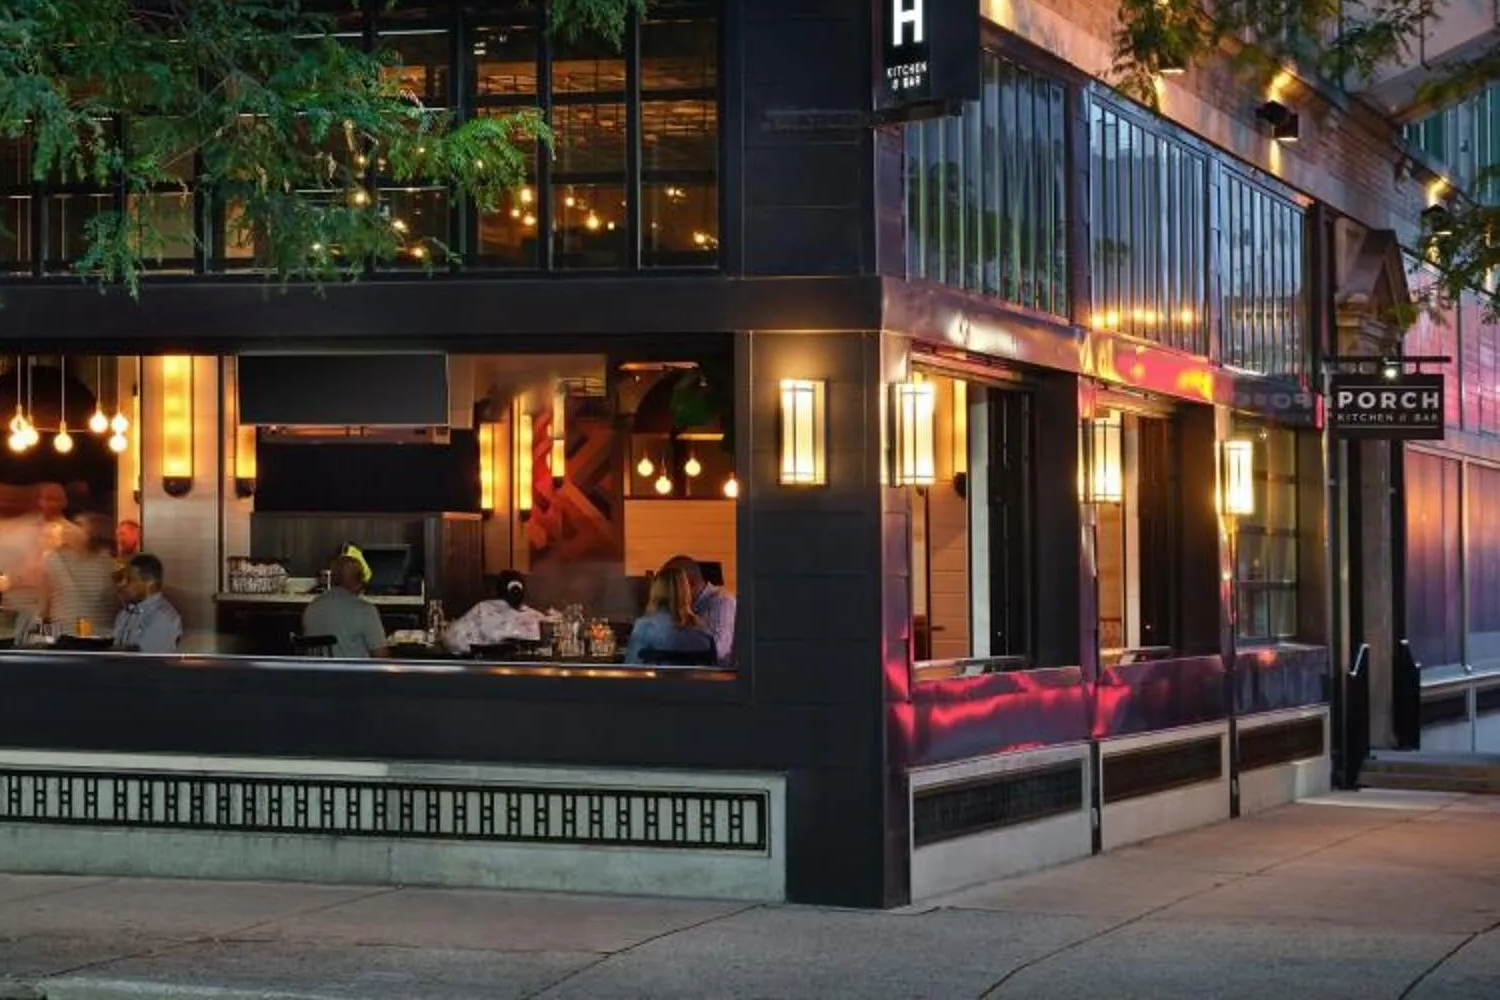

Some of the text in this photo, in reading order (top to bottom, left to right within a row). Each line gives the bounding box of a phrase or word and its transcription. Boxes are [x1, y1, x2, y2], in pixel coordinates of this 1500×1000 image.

[886, 61, 927, 78] KITCHEN
[1338, 391, 1439, 409] PORCH
[1337, 412, 1393, 422] KITCHEN
[1415, 412, 1438, 422] BAR
